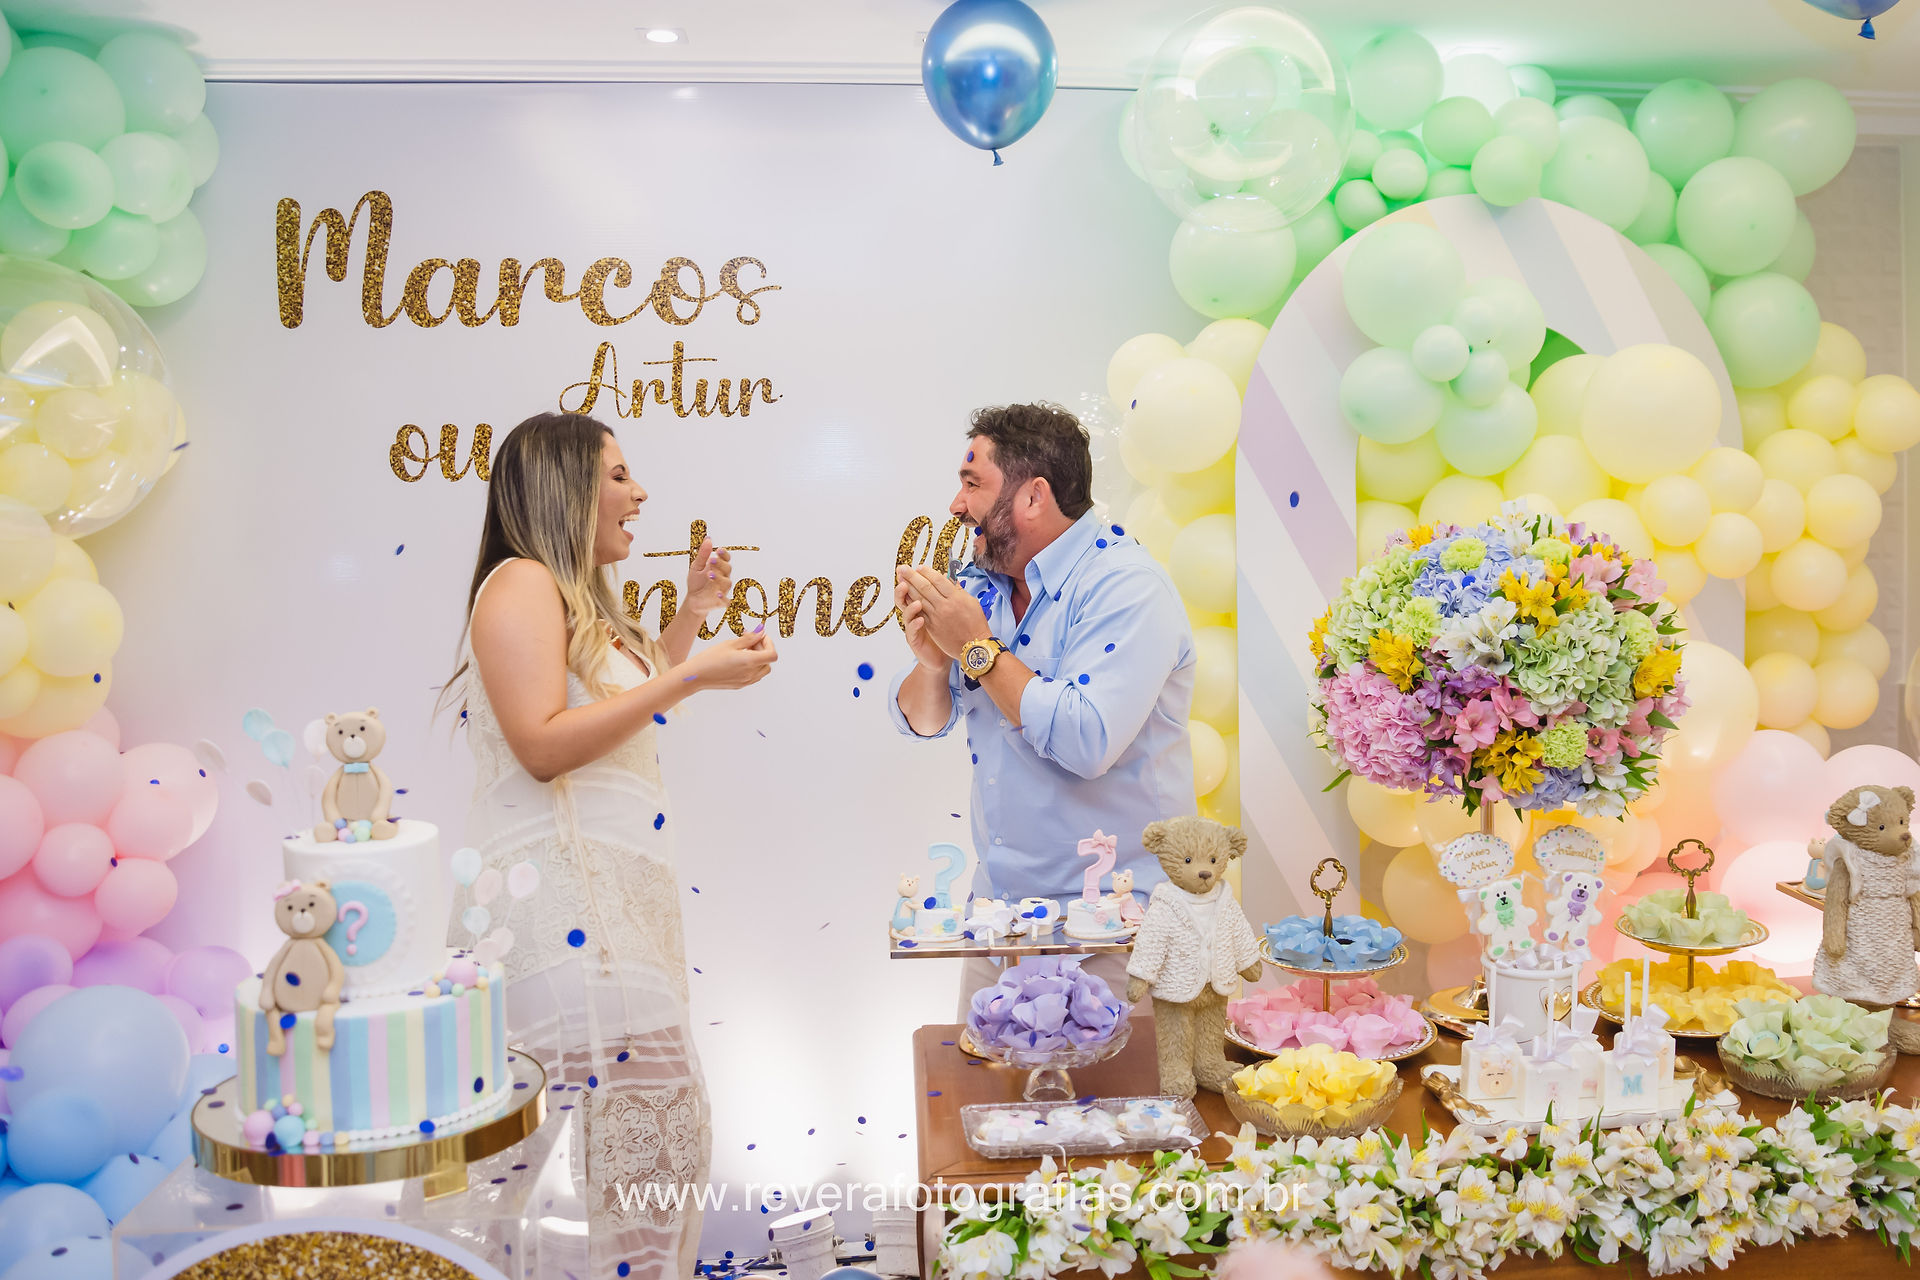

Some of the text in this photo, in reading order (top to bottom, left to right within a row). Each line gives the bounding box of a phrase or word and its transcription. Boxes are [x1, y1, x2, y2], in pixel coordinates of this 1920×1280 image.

[276, 190, 782, 329] Marcos
[559, 341, 783, 419] Artur
[389, 423, 493, 483] ou
[622, 515, 969, 641] ntonell
[337, 900, 369, 956] ?
[1621, 1073, 1645, 1097] M
